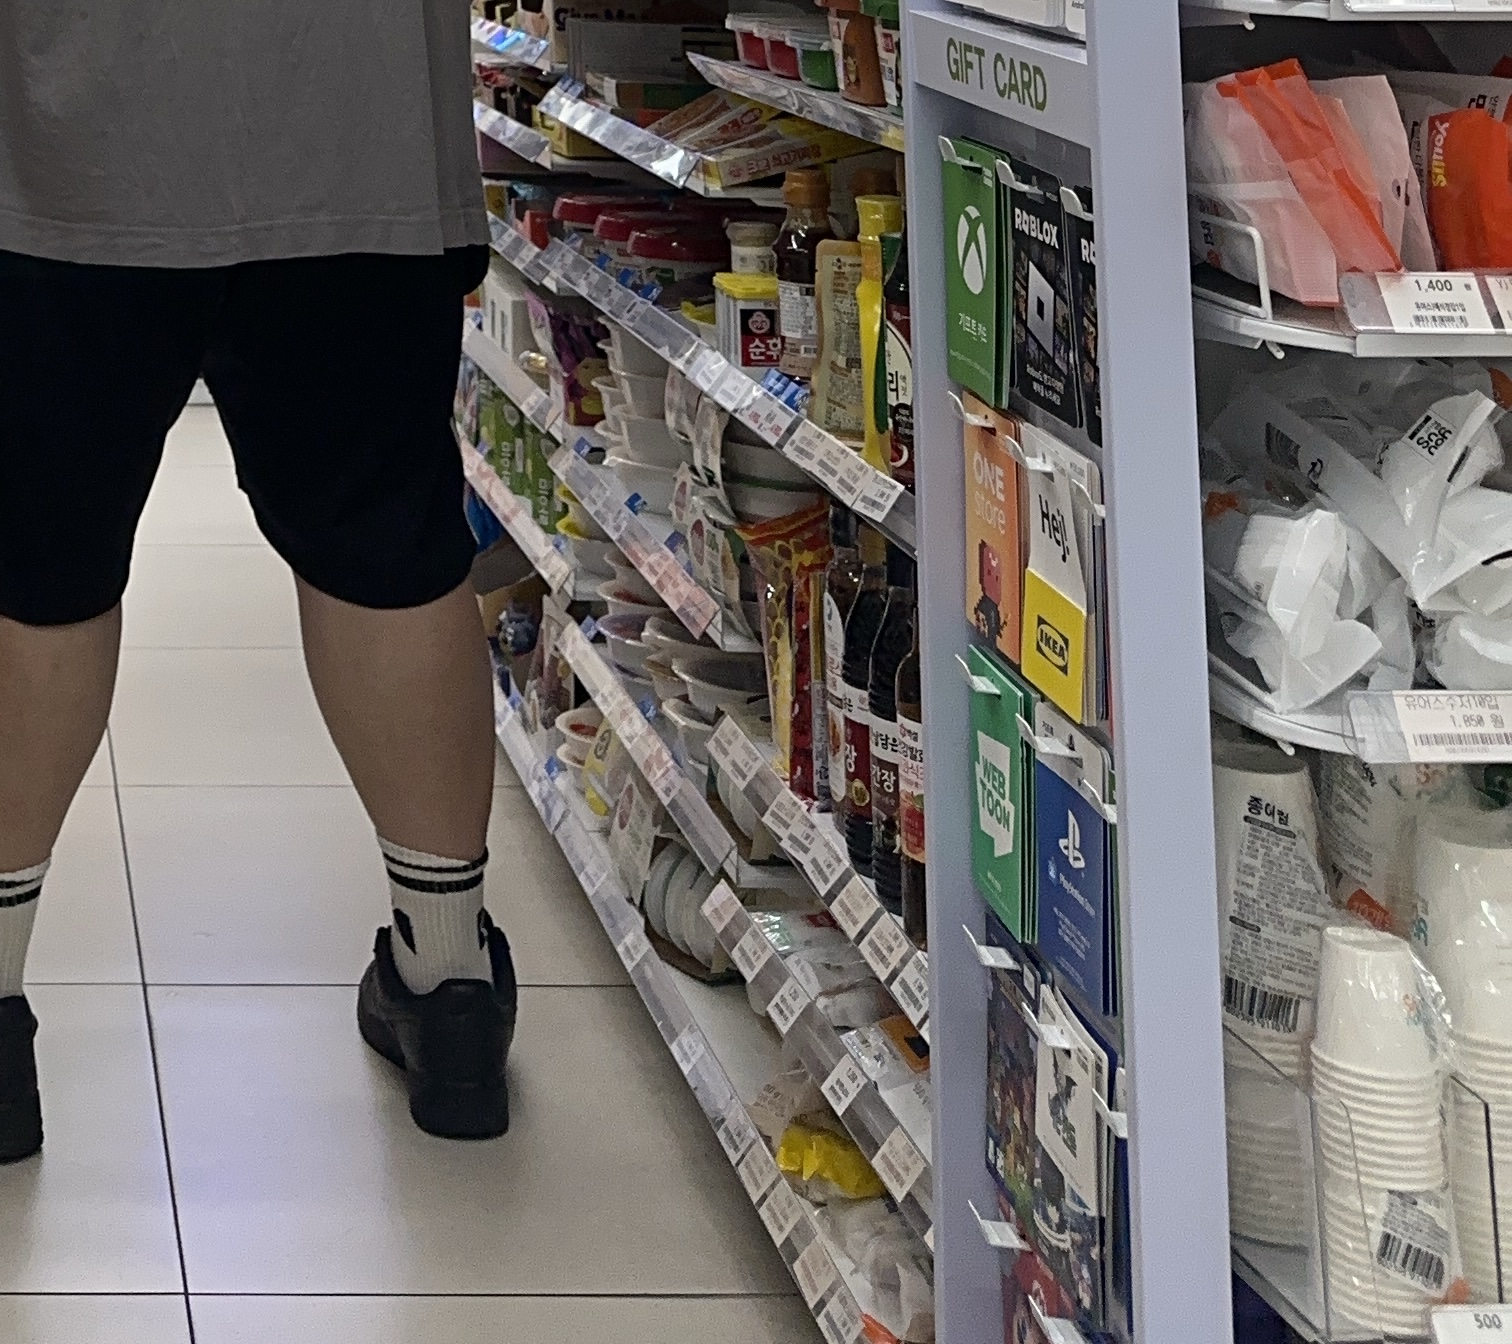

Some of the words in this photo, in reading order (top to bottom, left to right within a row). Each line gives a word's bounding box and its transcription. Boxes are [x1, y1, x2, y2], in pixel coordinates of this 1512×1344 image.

[946, 36, 986, 91] GIFT
[993, 51, 1048, 113] CARD
[1014, 207, 1060, 250] ROBLOX
[1414, 279, 1453, 292] 1,400
[972, 450, 1005, 502] ONE
[974, 489, 1006, 535] store
[1038, 493, 1070, 563] Hej!
[1038, 626, 1068, 664] IKEA
[1490, 714, 1505, 729] 원
[981, 755, 1007, 801] WEB
[979, 779, 1011, 833] TOON
[1246, 794, 1290, 826] 종이컵
